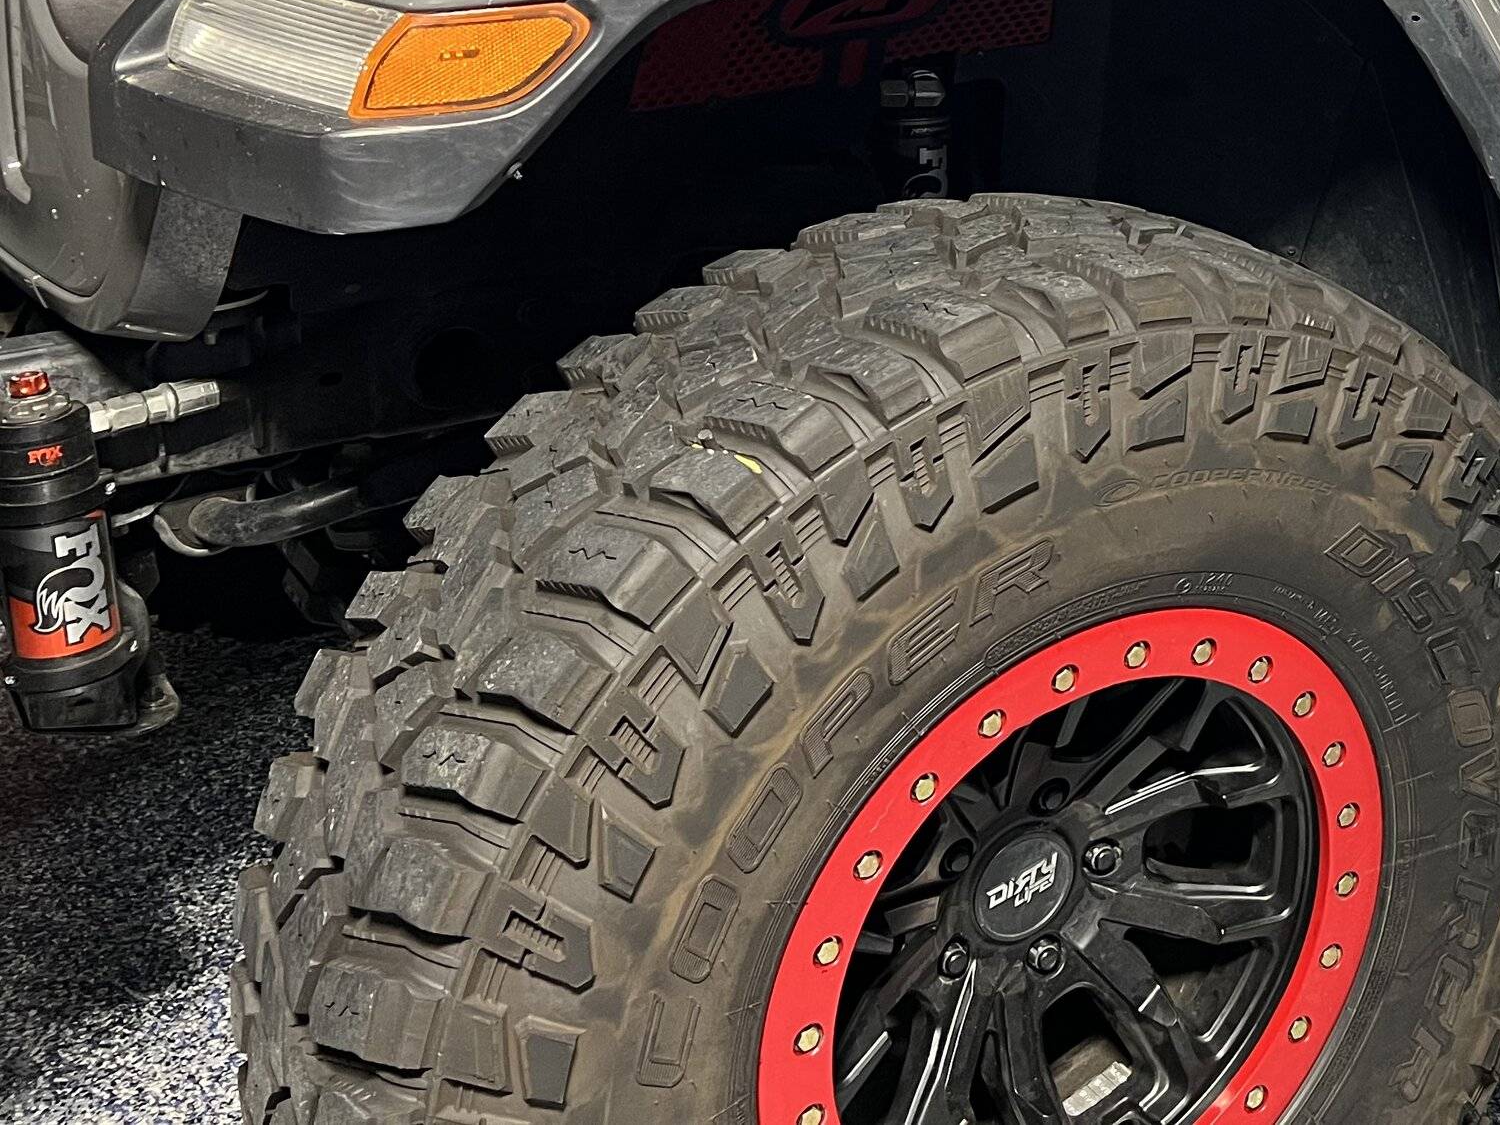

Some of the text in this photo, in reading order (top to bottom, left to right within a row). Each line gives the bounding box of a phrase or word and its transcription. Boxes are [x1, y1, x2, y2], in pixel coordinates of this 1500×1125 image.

[903, 145, 947, 198] FO
[28, 445, 63, 466] FOX
[34, 523, 111, 644] FOX
[636, 534, 1055, 1088] COOPER
[1323, 521, 1498, 1104] DISCOVERER
